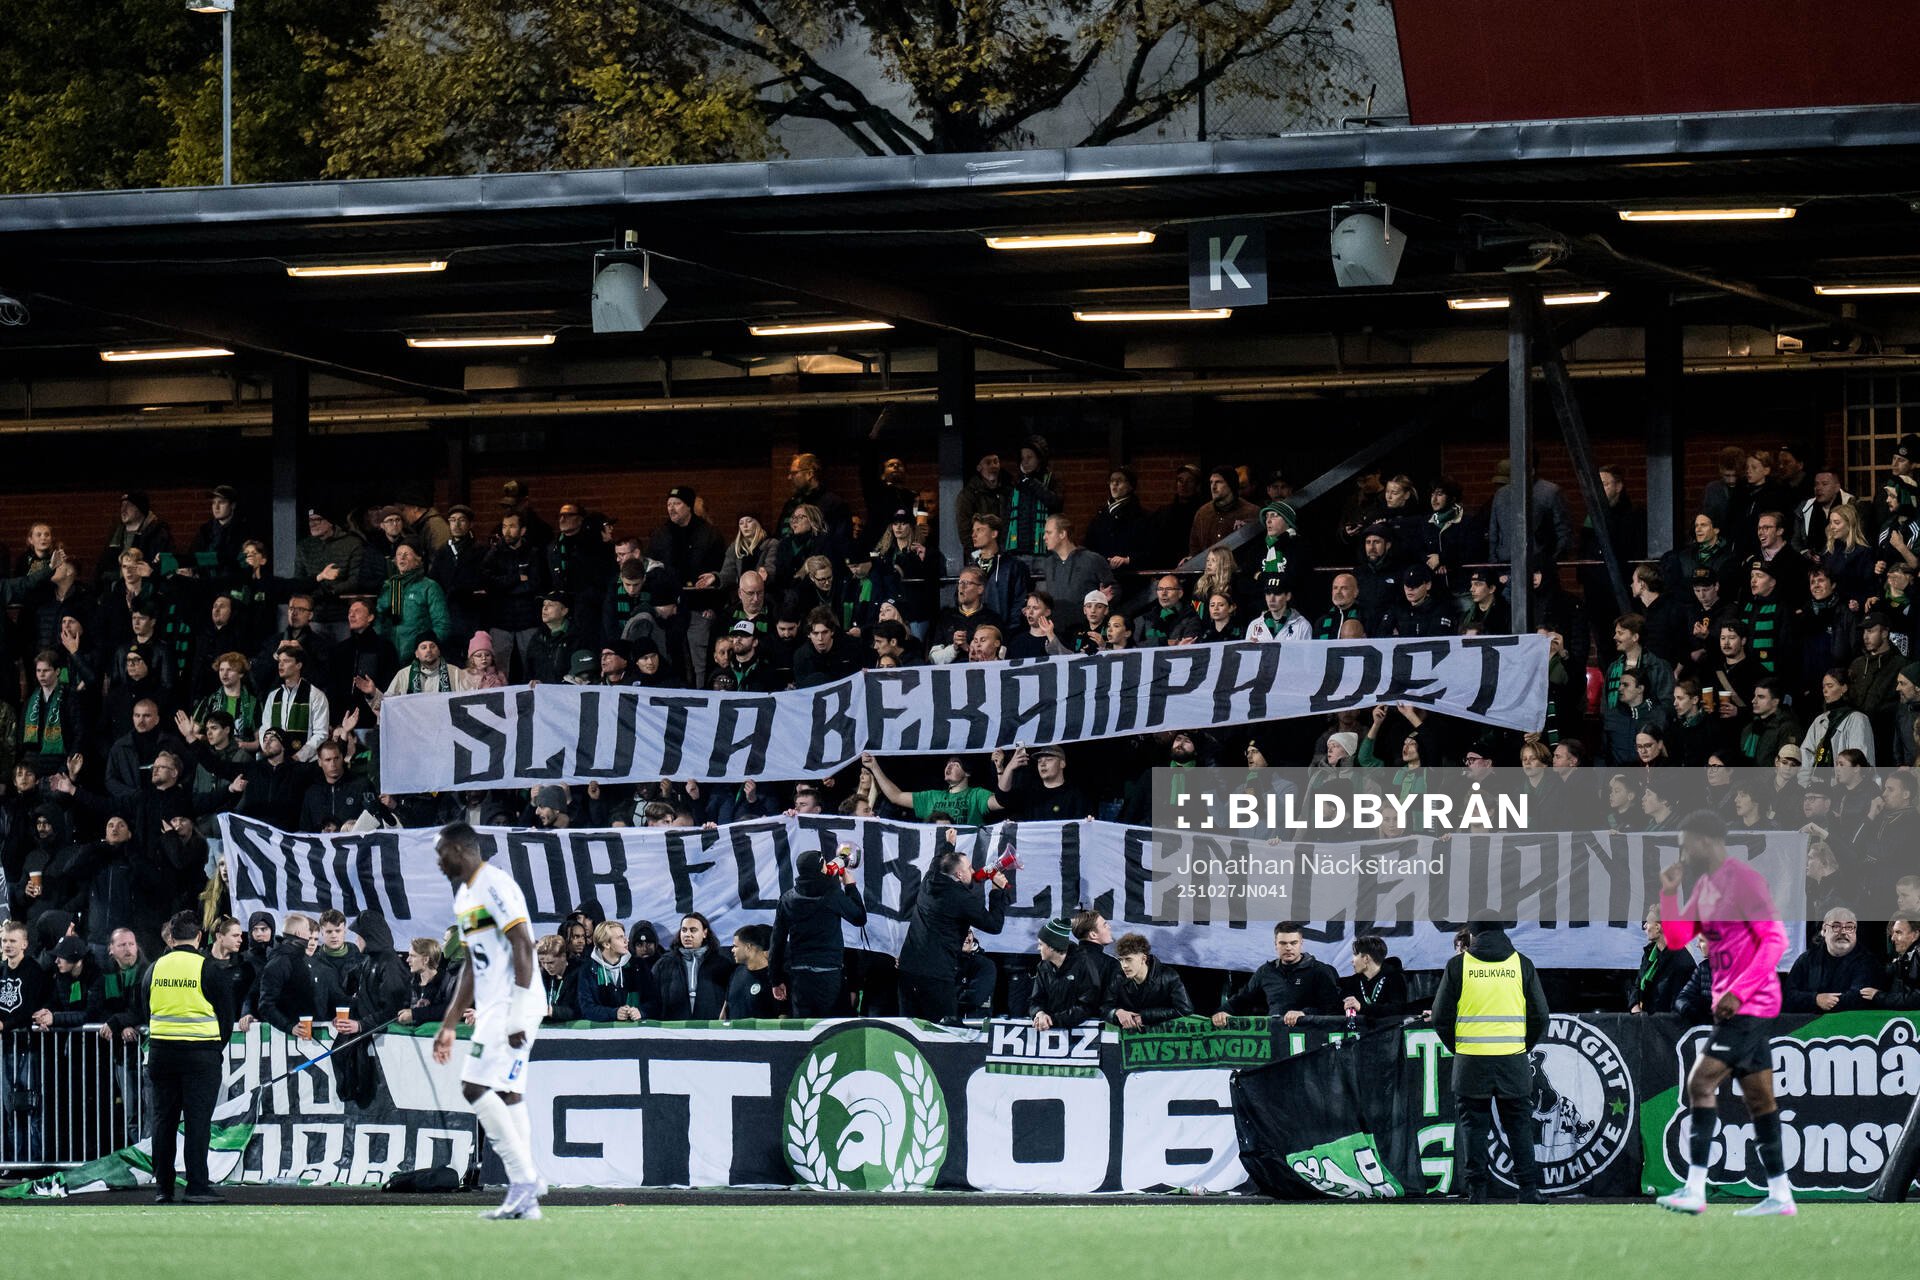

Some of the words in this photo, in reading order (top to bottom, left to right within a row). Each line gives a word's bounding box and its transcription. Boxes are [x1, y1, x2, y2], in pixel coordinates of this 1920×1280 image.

[1209, 235, 1252, 290] K
[449, 692, 776, 785] SLUTA
[803, 642, 1280, 771] BEKÄMPA
[1310, 637, 1519, 715] DET
[228, 814, 411, 920] SOM
[445, 828, 633, 923] ÖR
[1290, 831, 1766, 942] LEVAND
[992, 1025, 1099, 1058] KIDZ
[1128, 1034, 1271, 1062] AVSTÄNGDA
[1547, 1020, 1627, 1090] NIGHT
[1543, 1123, 1622, 1185] WHITE
